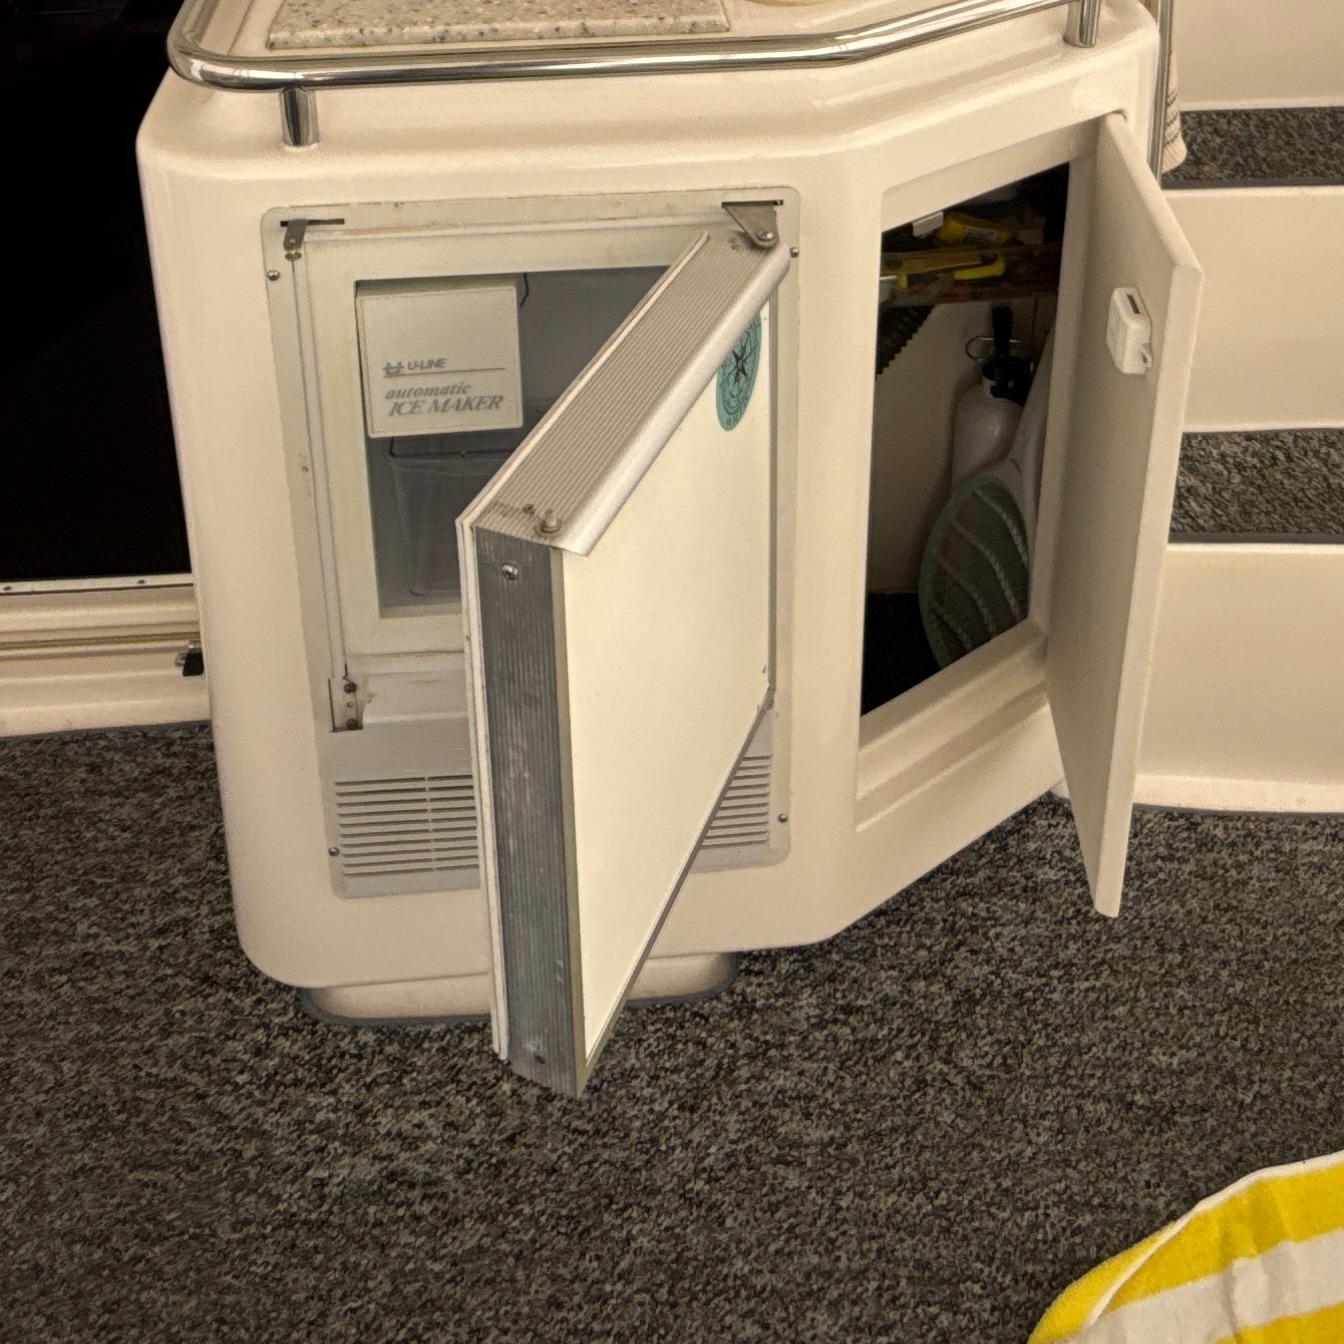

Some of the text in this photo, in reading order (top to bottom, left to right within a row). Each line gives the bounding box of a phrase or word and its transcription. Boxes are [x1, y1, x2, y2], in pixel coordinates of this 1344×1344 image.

[408, 358, 446, 370] U-LINE
[385, 381, 471, 399] automatic
[389, 395, 504, 416] ICE MAKER
